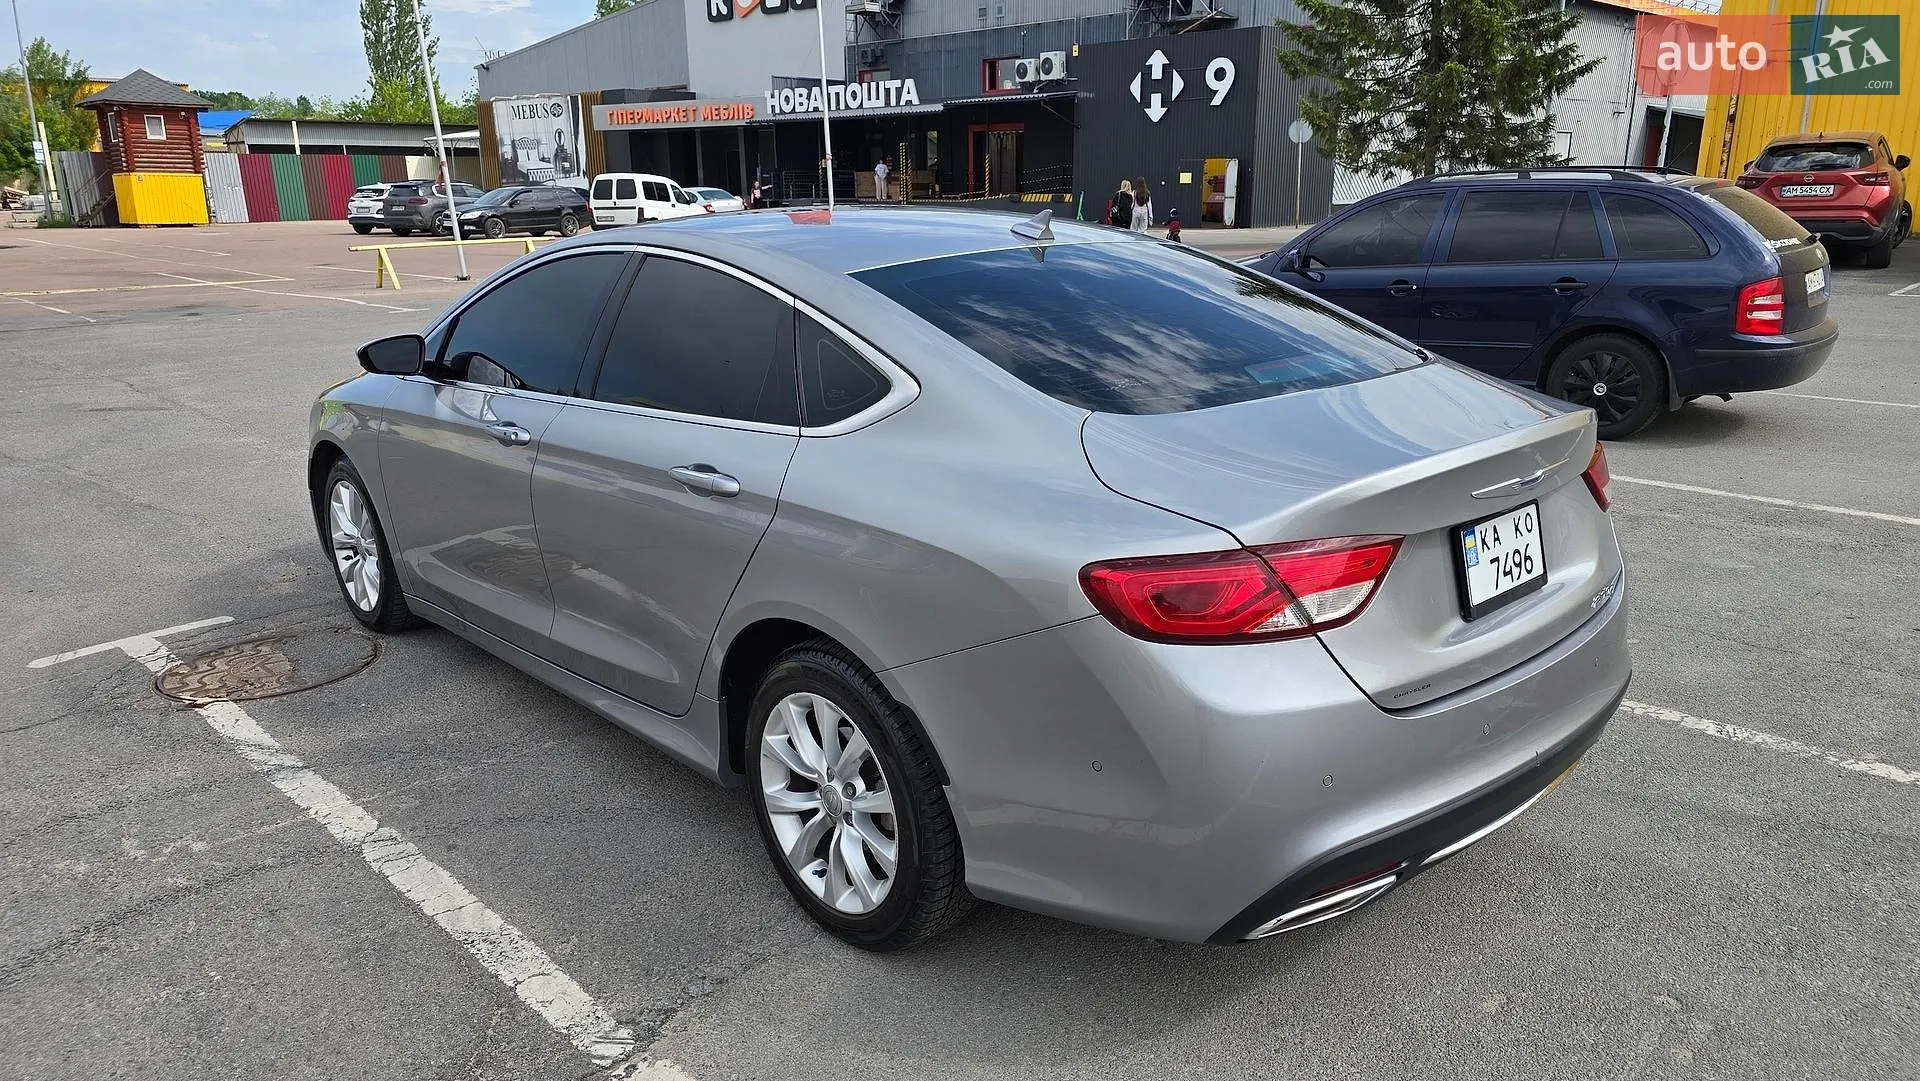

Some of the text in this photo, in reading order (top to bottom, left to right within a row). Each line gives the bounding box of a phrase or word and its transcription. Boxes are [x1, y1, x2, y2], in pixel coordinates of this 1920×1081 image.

[765, 78, 921, 114] НОВА ПОШТА
[1205, 57, 1236, 106] 9
[511, 103, 549, 120] MEBUS
[606, 103, 755, 125] ГІПЕРМАРКЕТ МЕБЛІВ
[1799, 186, 1818, 194] 5454
[1819, 186, 1831, 194] CX
[1480, 512, 1533, 552] KA KO
[1490, 543, 1533, 590] 7496
